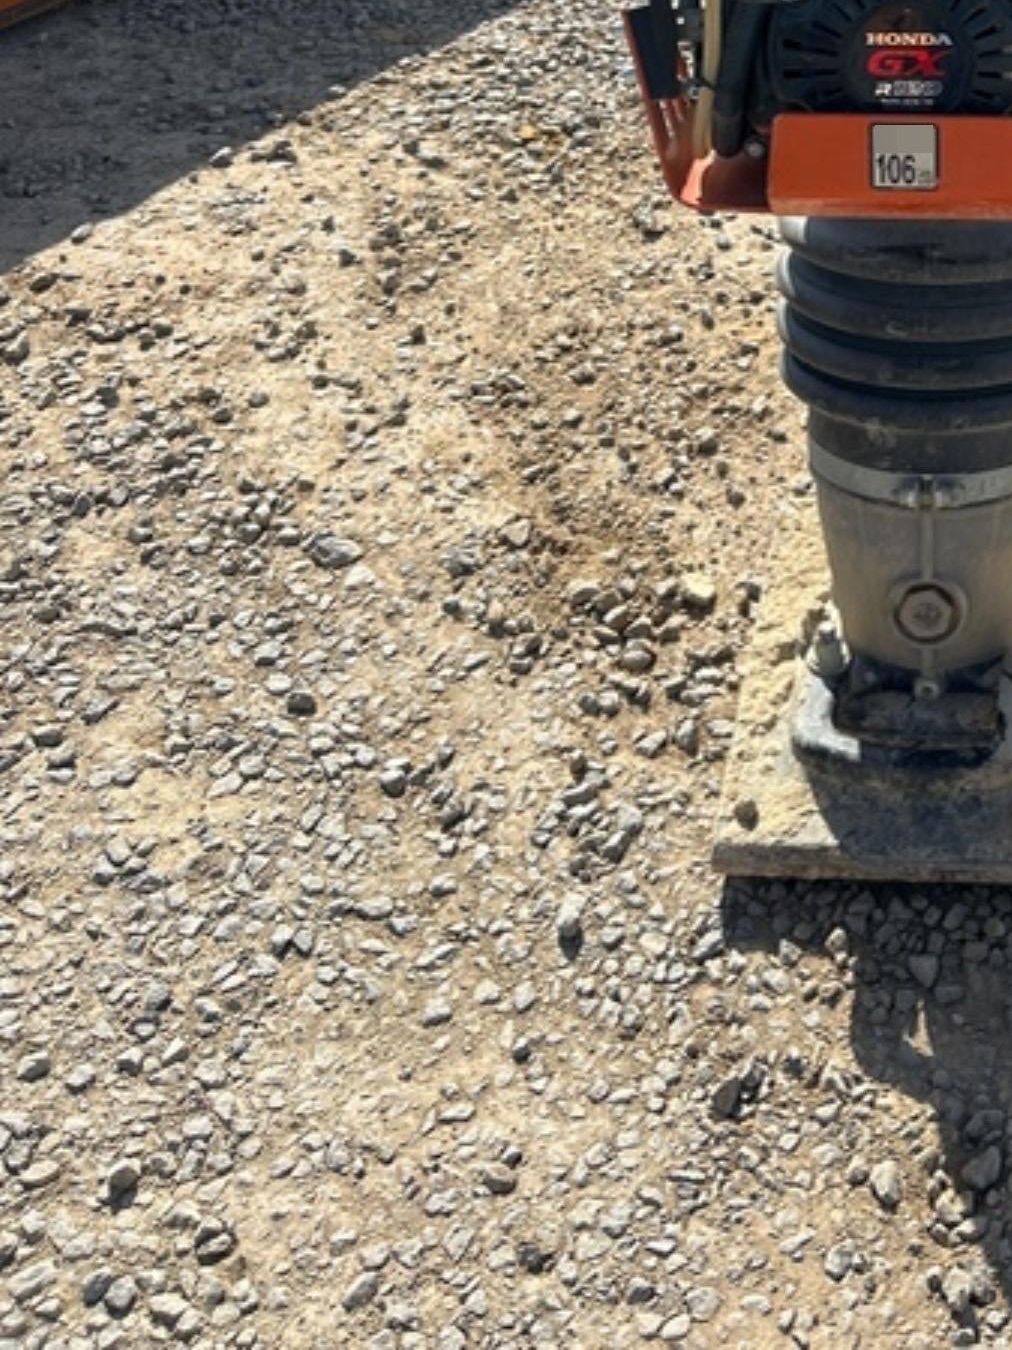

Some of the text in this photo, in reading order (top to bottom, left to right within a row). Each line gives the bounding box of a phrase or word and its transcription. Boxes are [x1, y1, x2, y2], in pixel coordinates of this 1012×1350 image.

[865, 31, 953, 46] HONDA
[867, 50, 950, 77] GX
[876, 153, 916, 184] 106
